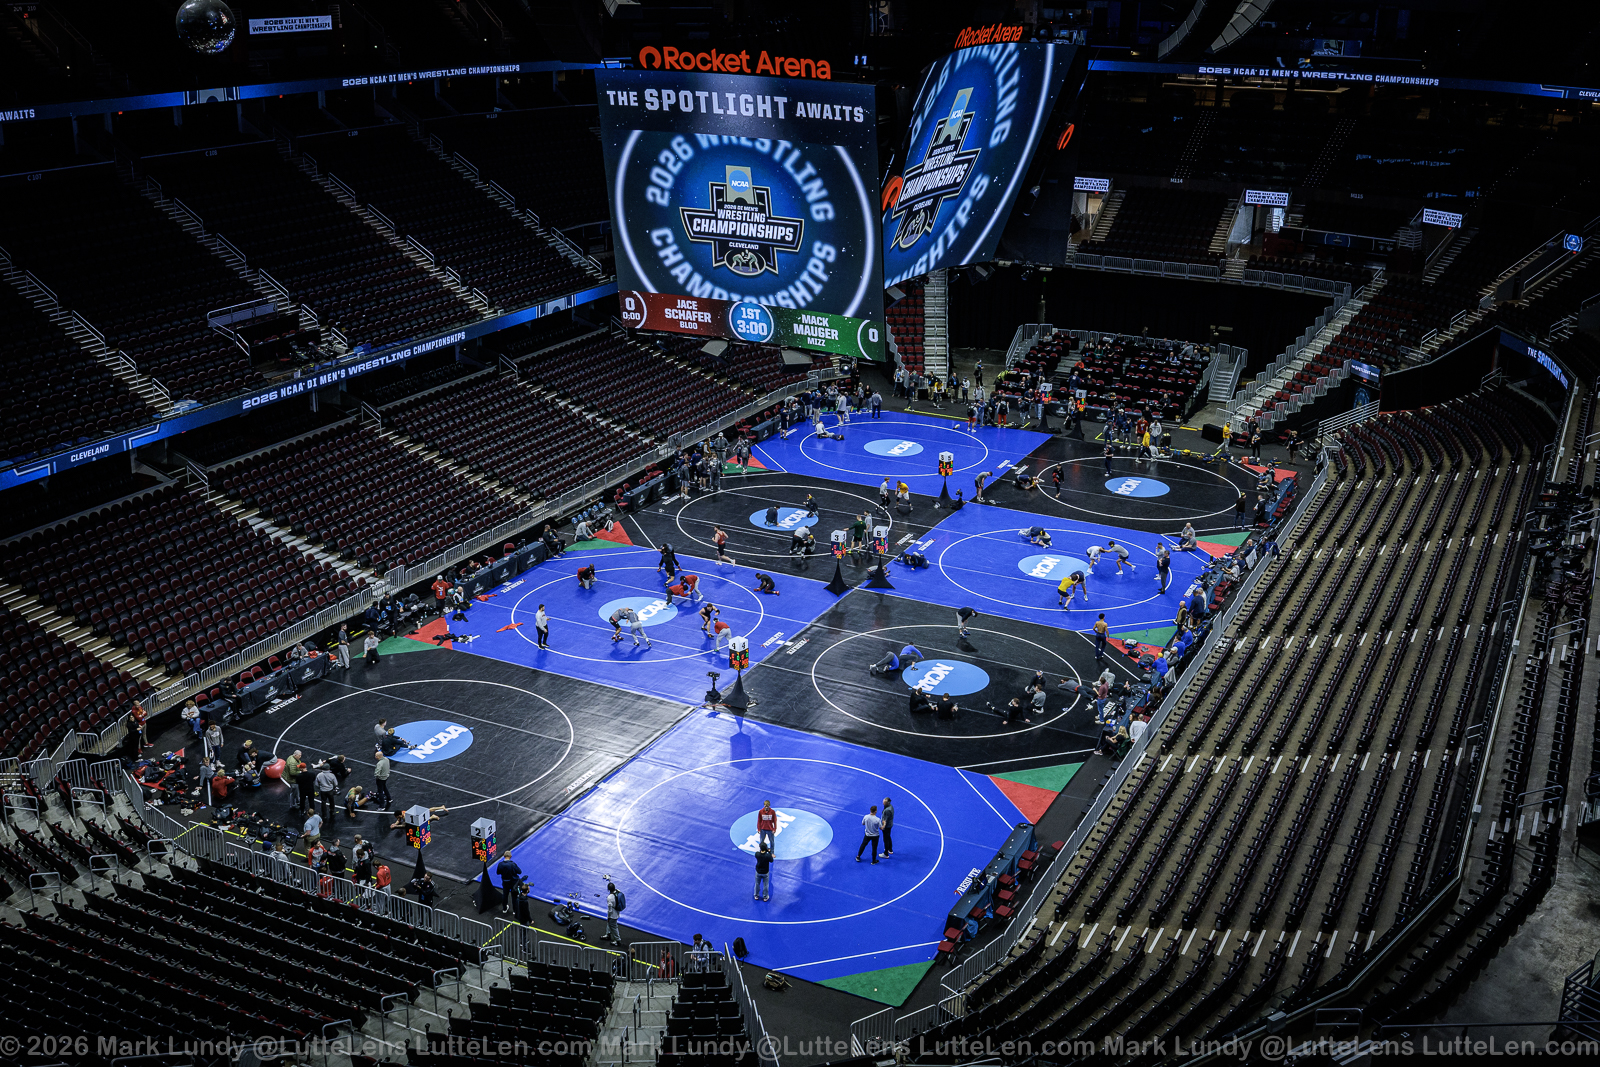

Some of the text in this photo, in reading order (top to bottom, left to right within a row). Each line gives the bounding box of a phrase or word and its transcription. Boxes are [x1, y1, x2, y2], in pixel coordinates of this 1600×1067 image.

[962, 23, 1023, 47] Rocket Arena
[663, 46, 831, 79] Rocket Arena
[342, 78, 368, 86] 2026
[398, 72, 417, 81] MEN'S
[419, 68, 467, 79] WRESTLING
[468, 65, 520, 74] CHAMPIONSHIPS
[1271, 70, 1299, 78] MEN'S
[1301, 72, 1372, 81] WRESTLING
[1375, 75, 1440, 86] CHAMPIONSHIPS
[607, 88, 864, 122] THE SPOTLIGHT AWAITS
[0, 109, 35, 122] AWAITS
[900, 163, 969, 202] CHAMPIONSHIPS
[717, 209, 766, 224] WRESTLING
[693, 218, 794, 241] CHAMPIONSHIPS
[729, 242, 759, 250] CLEVELAND
[625, 298, 635, 310] 0
[676, 299, 697, 310] JACE
[664, 308, 711, 323] SCHAFER
[741, 307, 761, 321] 1ST
[802, 315, 829, 327] MACK
[736, 320, 768, 335] 3:00
[793, 324, 838, 340] MAUGER
[807, 337, 826, 346] MIZZ
[868, 329, 878, 343] 0
[1527, 347, 1537, 358] THE
[242, 332, 466, 409] 2026 NCAA DI MEN'S WRESTLING CHAMPIONSHIPS
[70, 444, 110, 462] CLEVELAND
[887, 441, 917, 455] NCAA
[1115, 478, 1142, 495] NCAA
[778, 510, 810, 529] NCAA
[1028, 556, 1061, 578] NCAA
[912, 662, 954, 692] NCAA
[408, 725, 469, 760] NCAA
[410, 815, 414, 824] 1
[423, 813, 426, 822] 1
[476, 828, 481, 837] 2
[488, 826, 492, 835] 2
